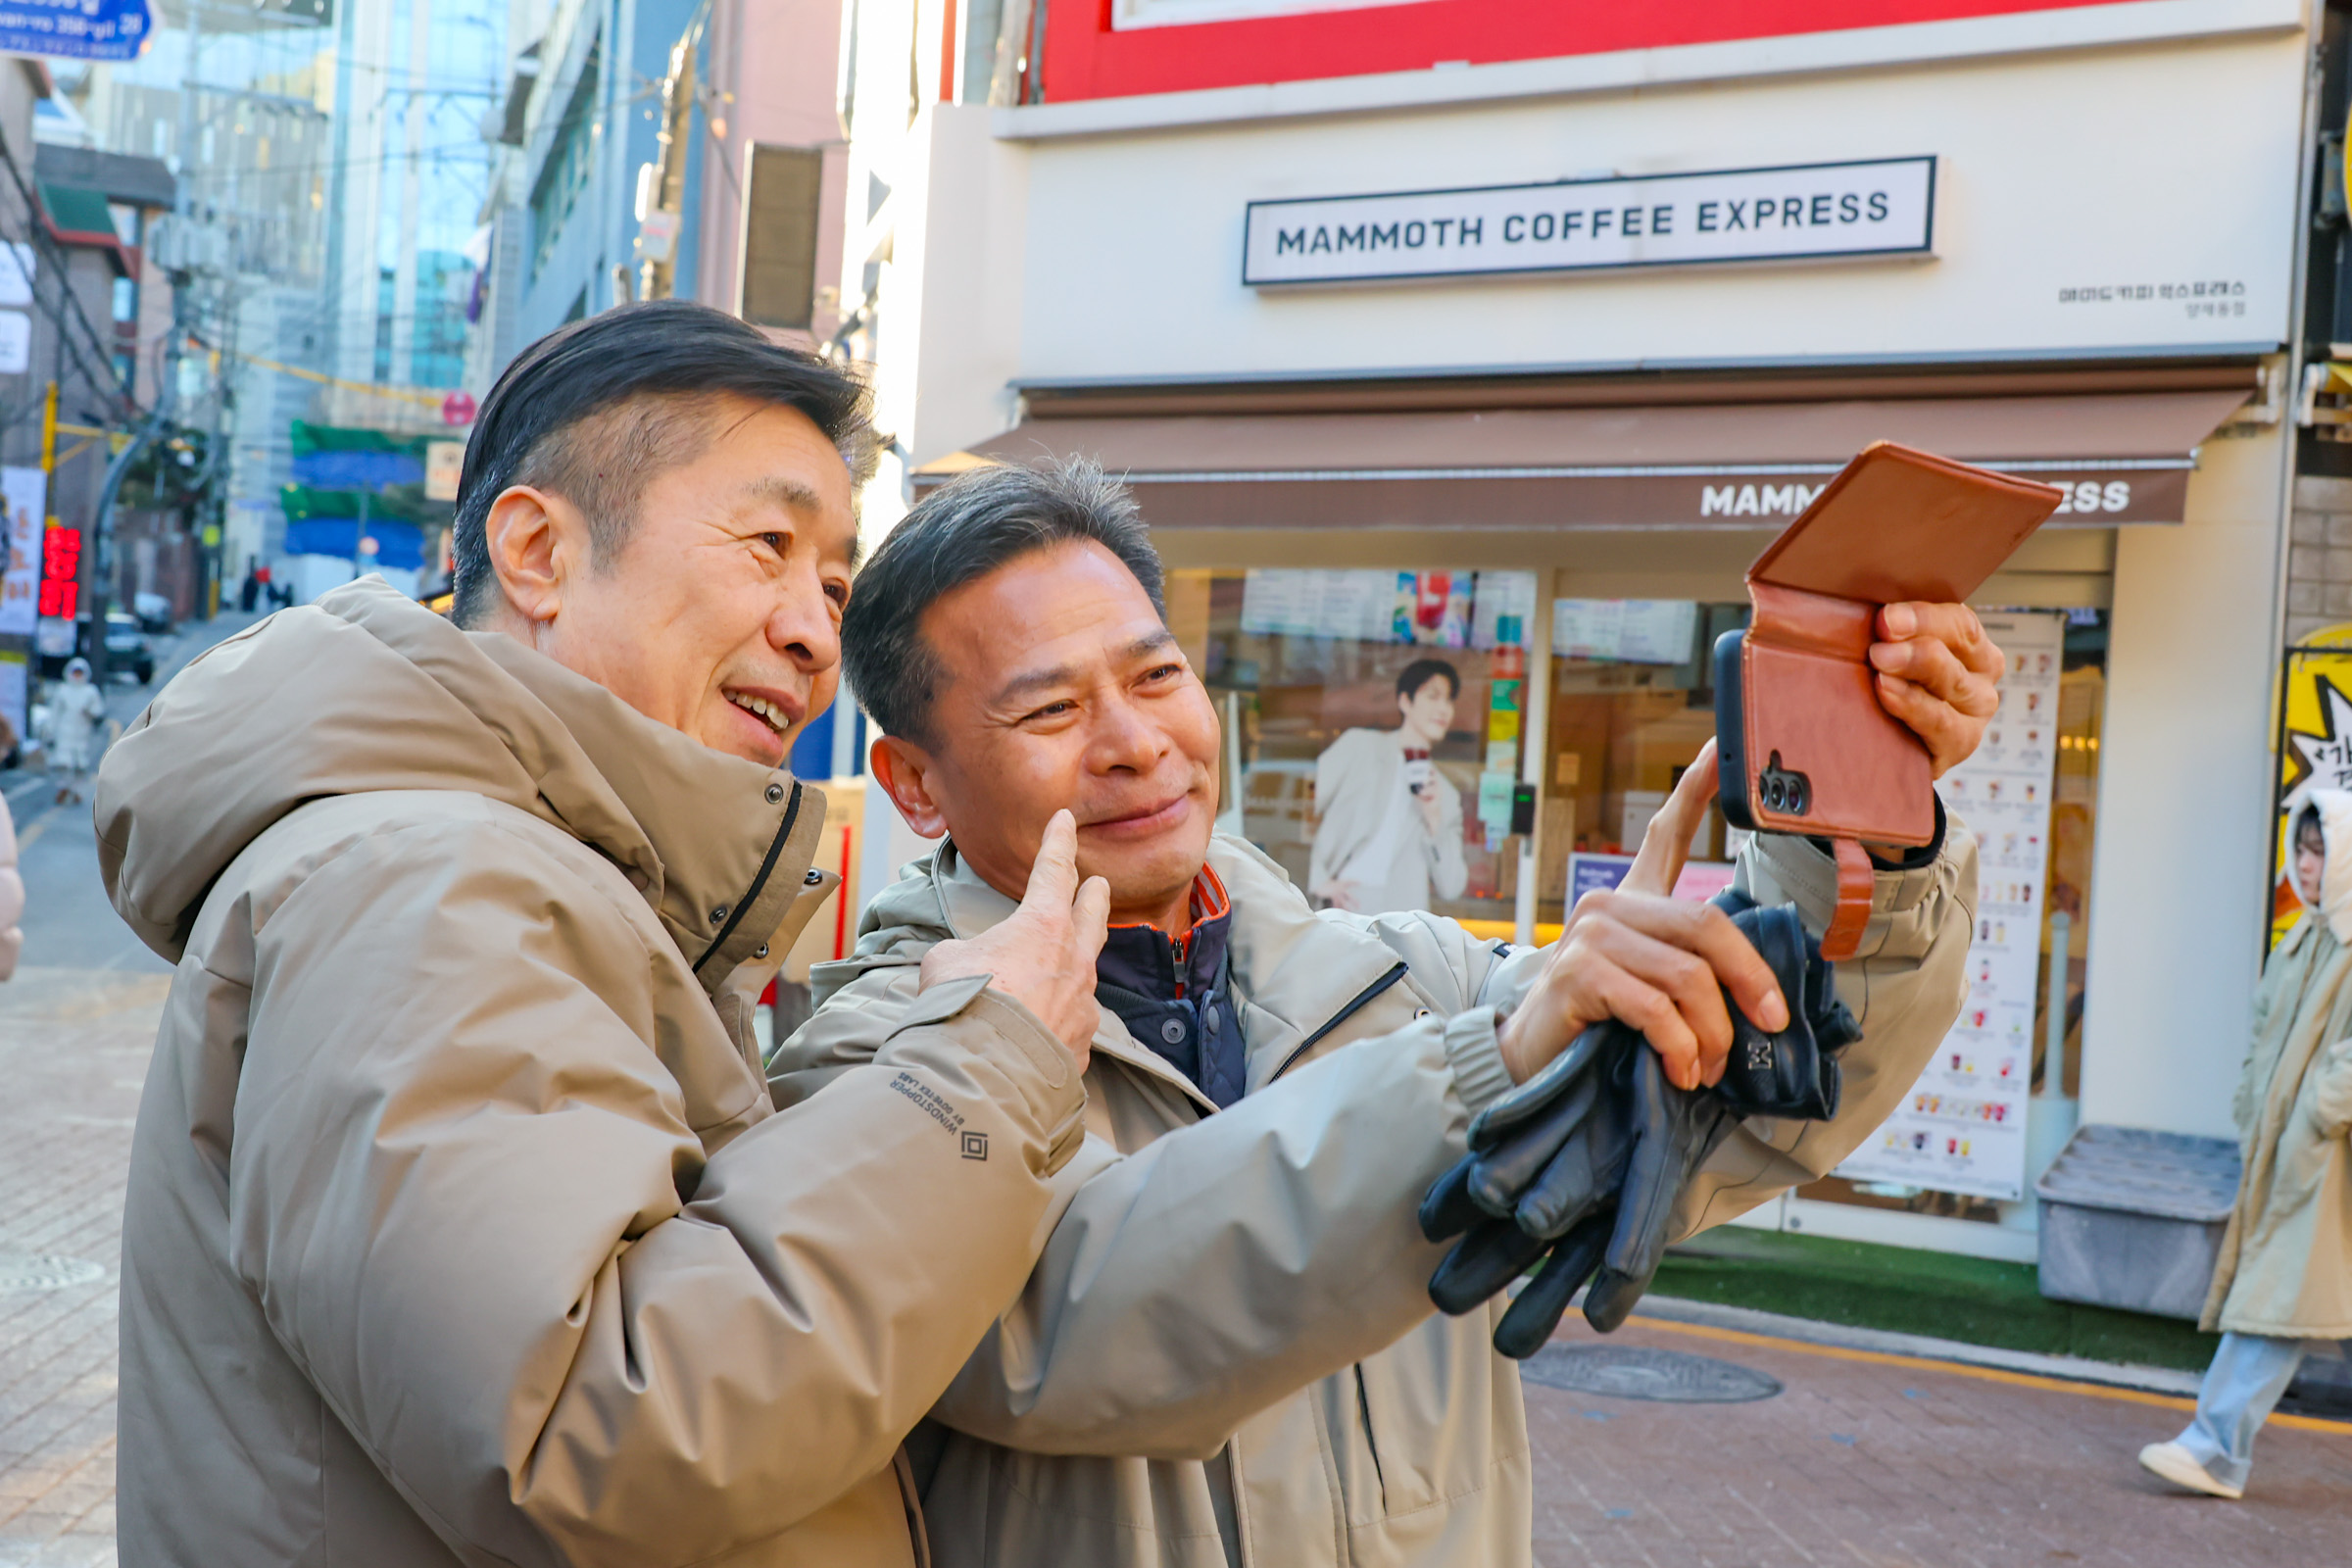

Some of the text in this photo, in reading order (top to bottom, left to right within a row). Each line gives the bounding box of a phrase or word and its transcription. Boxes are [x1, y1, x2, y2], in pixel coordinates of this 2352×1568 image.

[1277, 192, 1889, 255] MAMMOTH COFFEE EXPRESS
[1700, 483, 1826, 516] MAMM
[889, 1079, 957, 1136] WINDSTOPPER
[898, 1071, 965, 1126] BY GORE-TEX LABS
